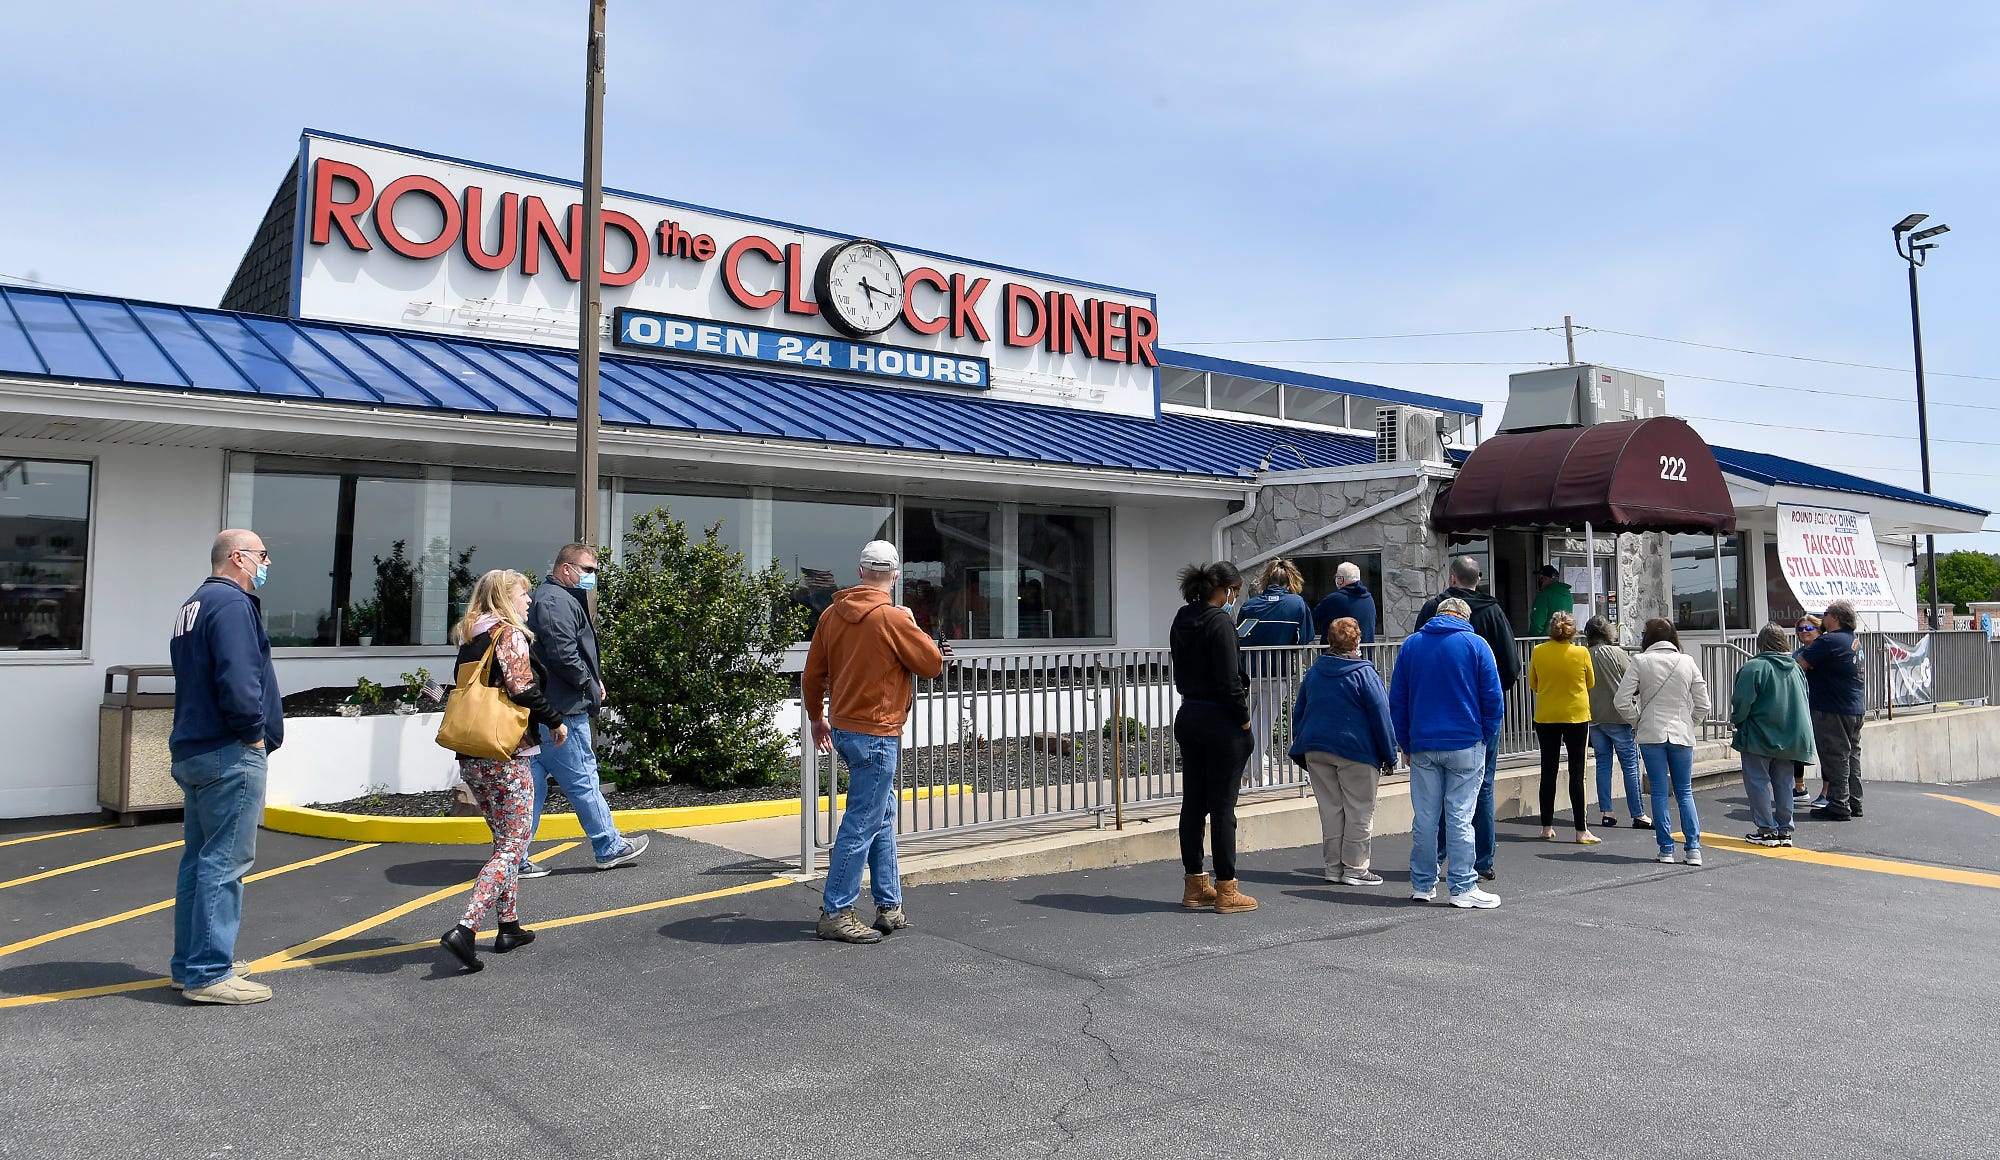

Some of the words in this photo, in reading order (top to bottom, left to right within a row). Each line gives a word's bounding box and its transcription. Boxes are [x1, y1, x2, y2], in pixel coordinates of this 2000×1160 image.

[311, 157, 650, 286] ROUND
[656, 219, 716, 262] the
[1003, 282, 1159, 368] DINER
[629, 316, 759, 357] OPEN
[776, 336, 832, 366] 24
[850, 348, 982, 384] HOURS
[1660, 455, 1688, 482] 222
[1791, 511, 1813, 524] ROUND
[1802, 533, 1856, 556] TAKEOUT
[1786, 556, 1821, 578] STILL
[1821, 557, 1880, 579] AVAILABLE
[1799, 580, 1828, 596] CALL:
